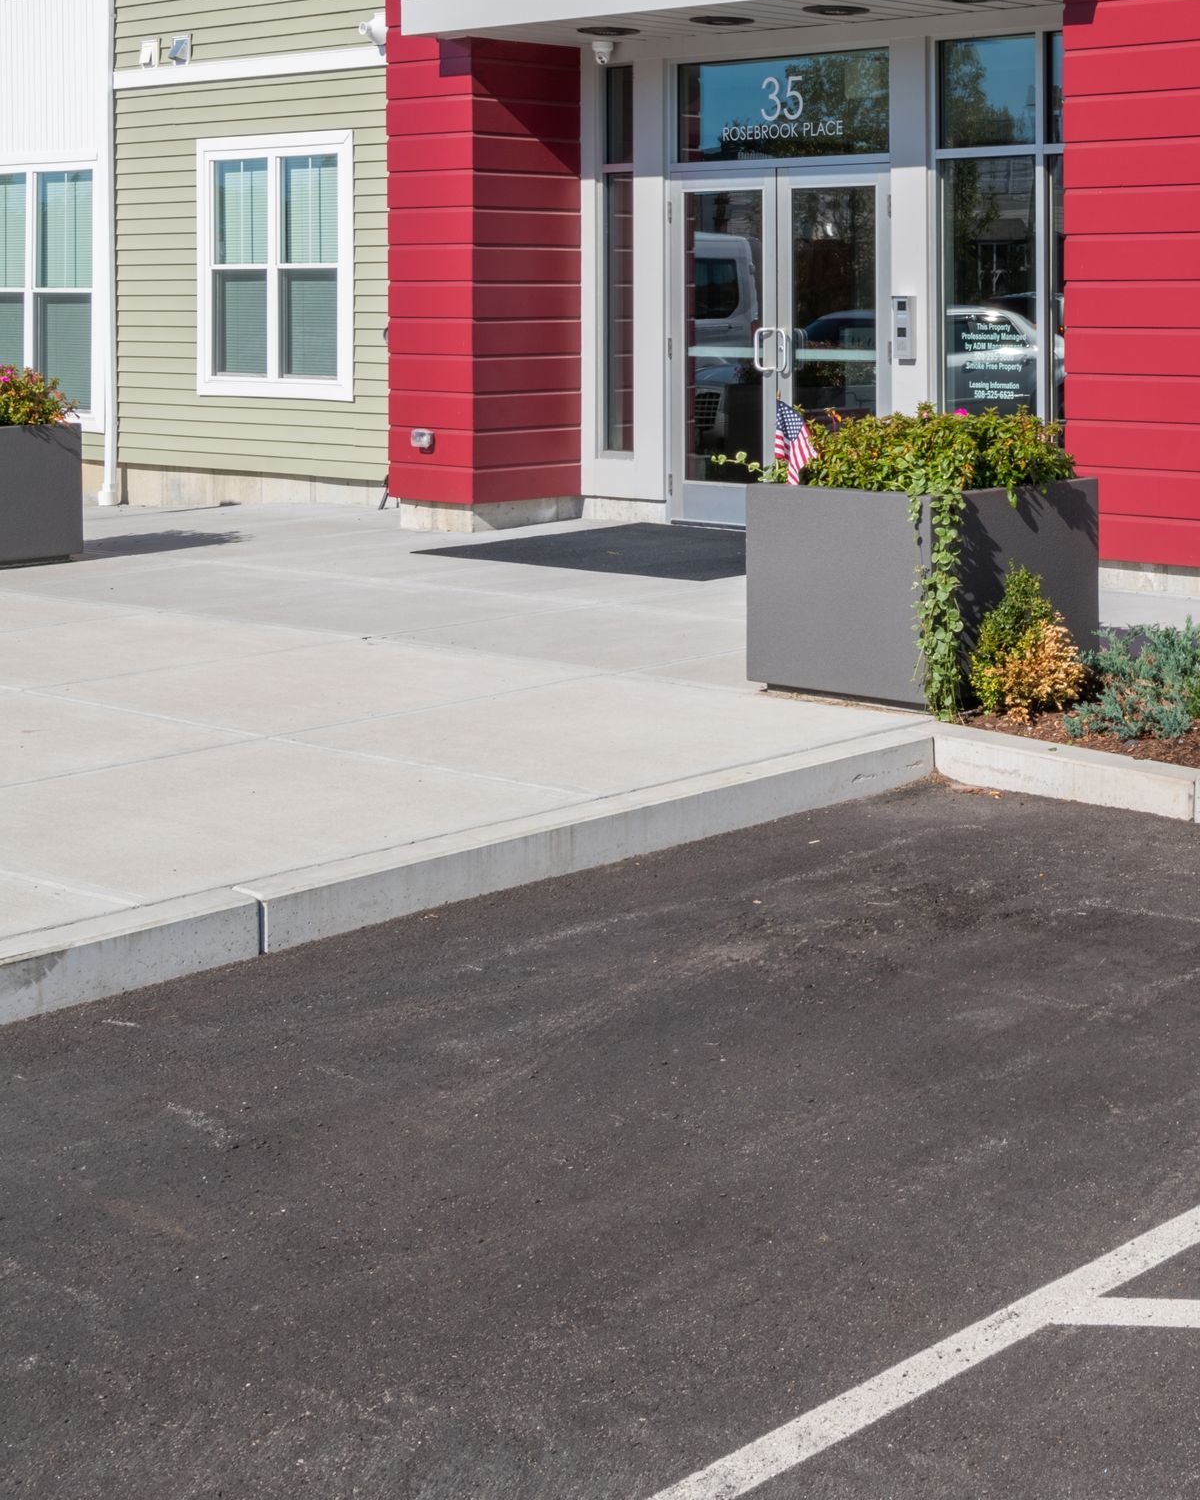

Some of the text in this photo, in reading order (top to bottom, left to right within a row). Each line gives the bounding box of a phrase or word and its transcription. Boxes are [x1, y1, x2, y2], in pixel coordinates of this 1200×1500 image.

[761, 75, 804, 121] 35
[722, 120, 844, 141] ROSEBROOK PLACE
[977, 323, 1011, 332] This Property
[961, 332, 1027, 342] Professionally Managed
[964, 342, 972, 351] by
[965, 362, 1023, 372] Smoke Free Property
[969, 381, 1020, 390] Leasing Information
